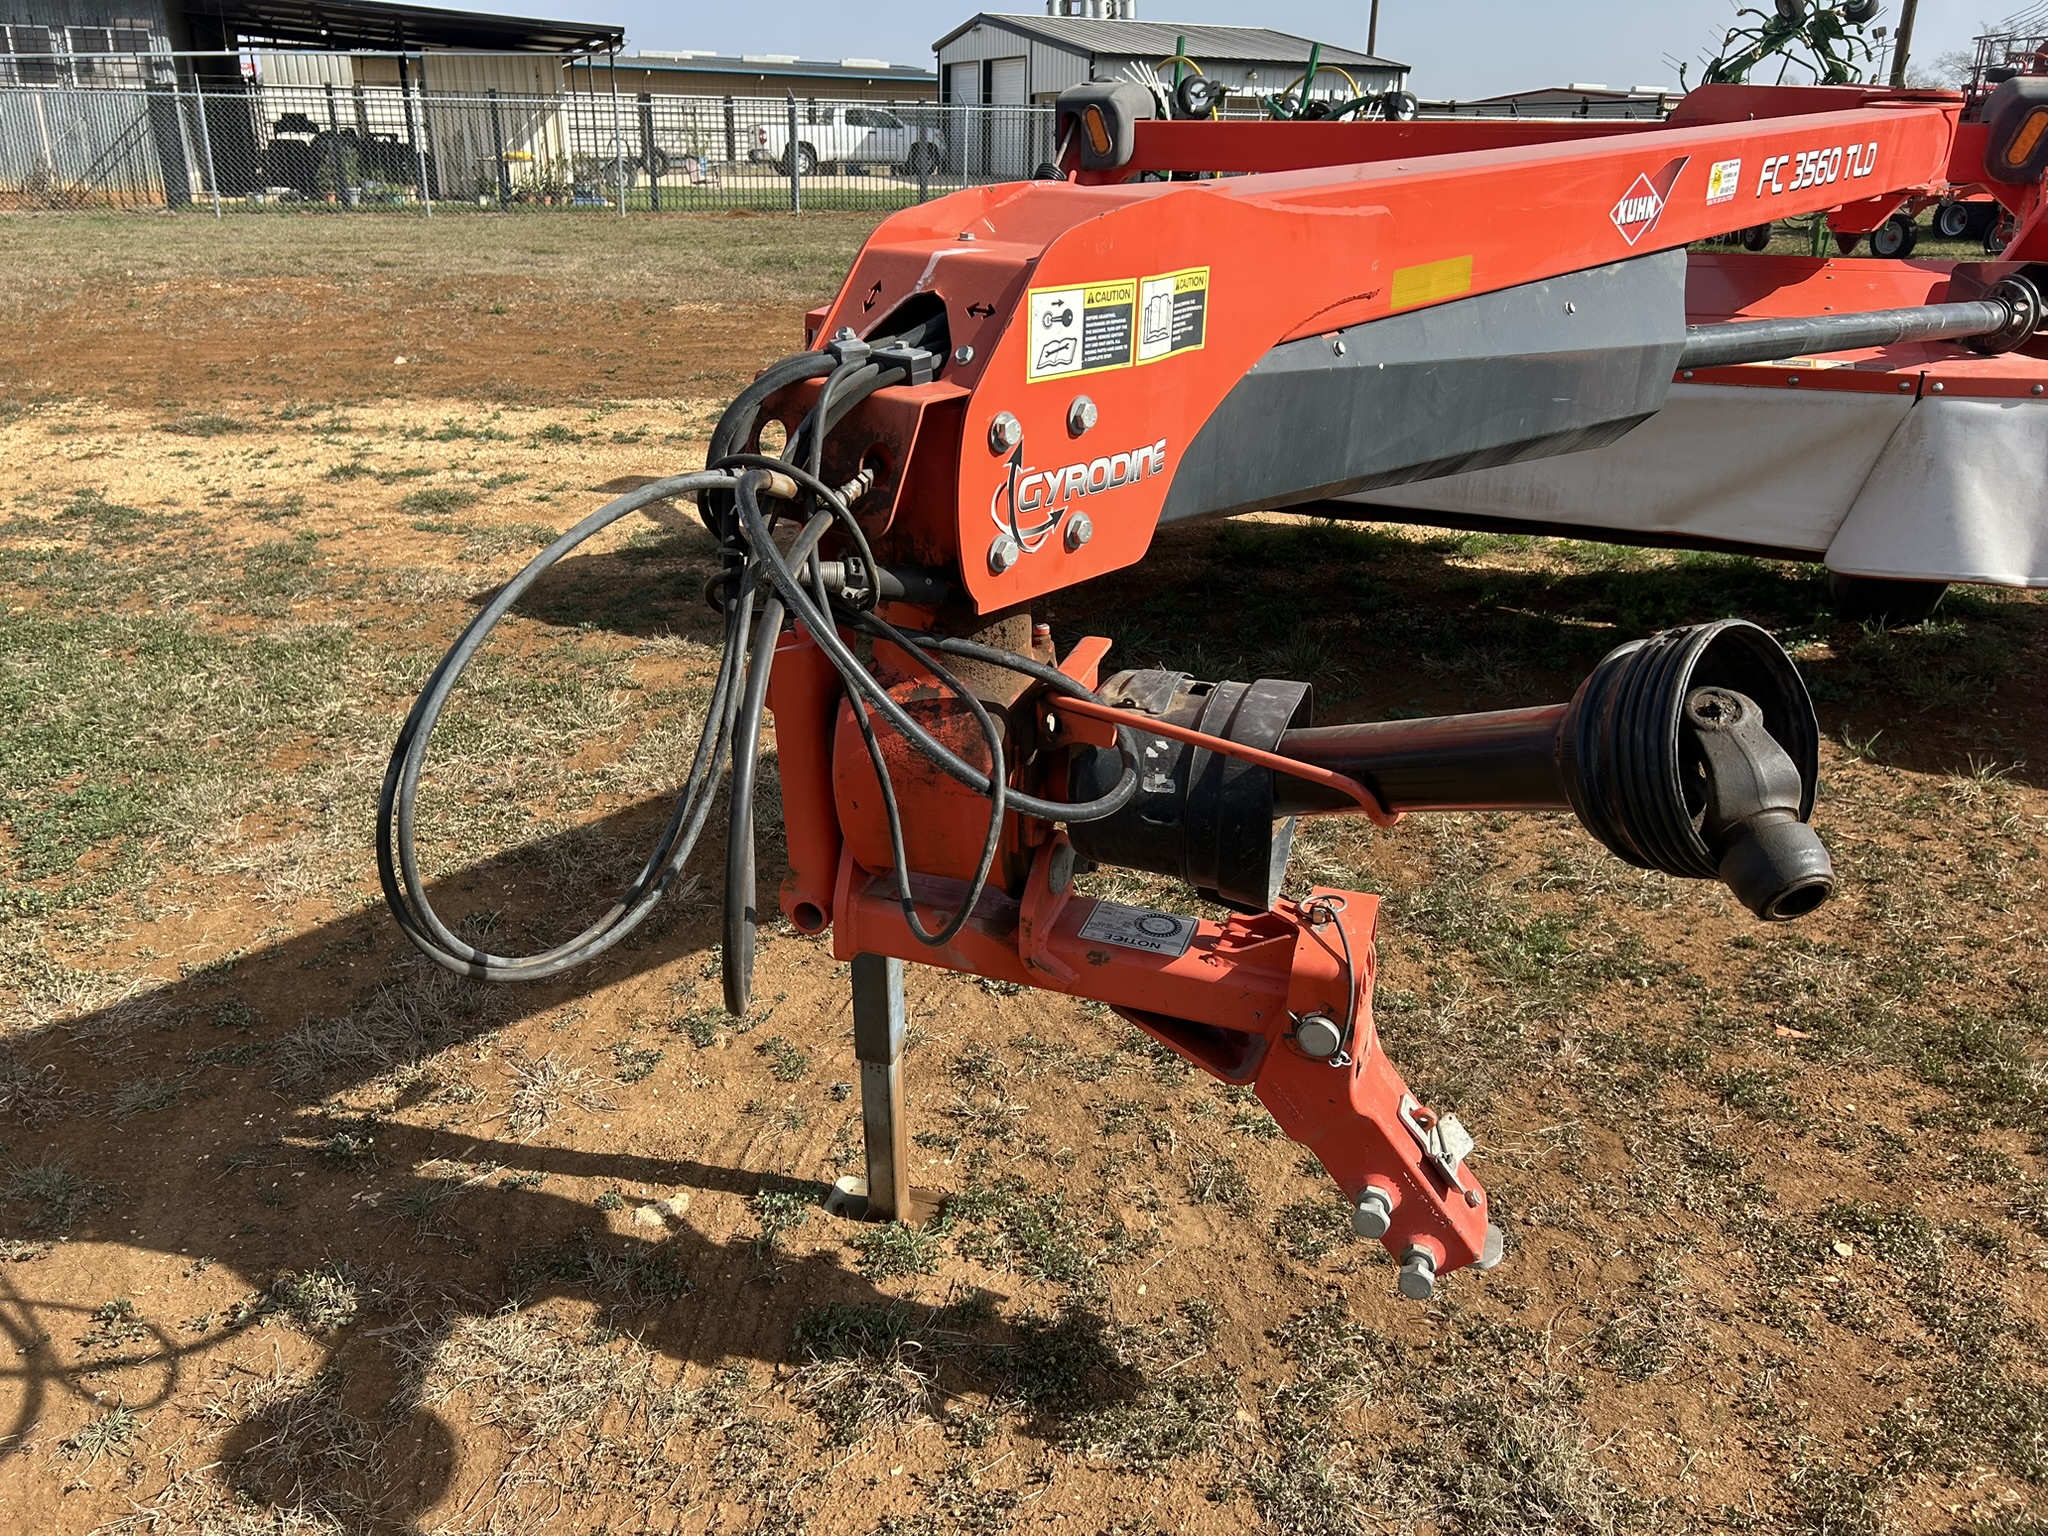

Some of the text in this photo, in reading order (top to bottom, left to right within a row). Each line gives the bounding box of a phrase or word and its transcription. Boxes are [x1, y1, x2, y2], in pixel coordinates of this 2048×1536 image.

[1756, 154, 1790, 198] FC
[1789, 146, 1842, 191] 3560
[1843, 142, 1878, 181] TLD
[1616, 195, 1657, 225] KUHN
[1179, 276, 1204, 289] CAUTION
[1095, 289, 1131, 303] CAUTION
[1018, 437, 1167, 512] GYRODINE
[1103, 933, 1161, 950] NOTICE
